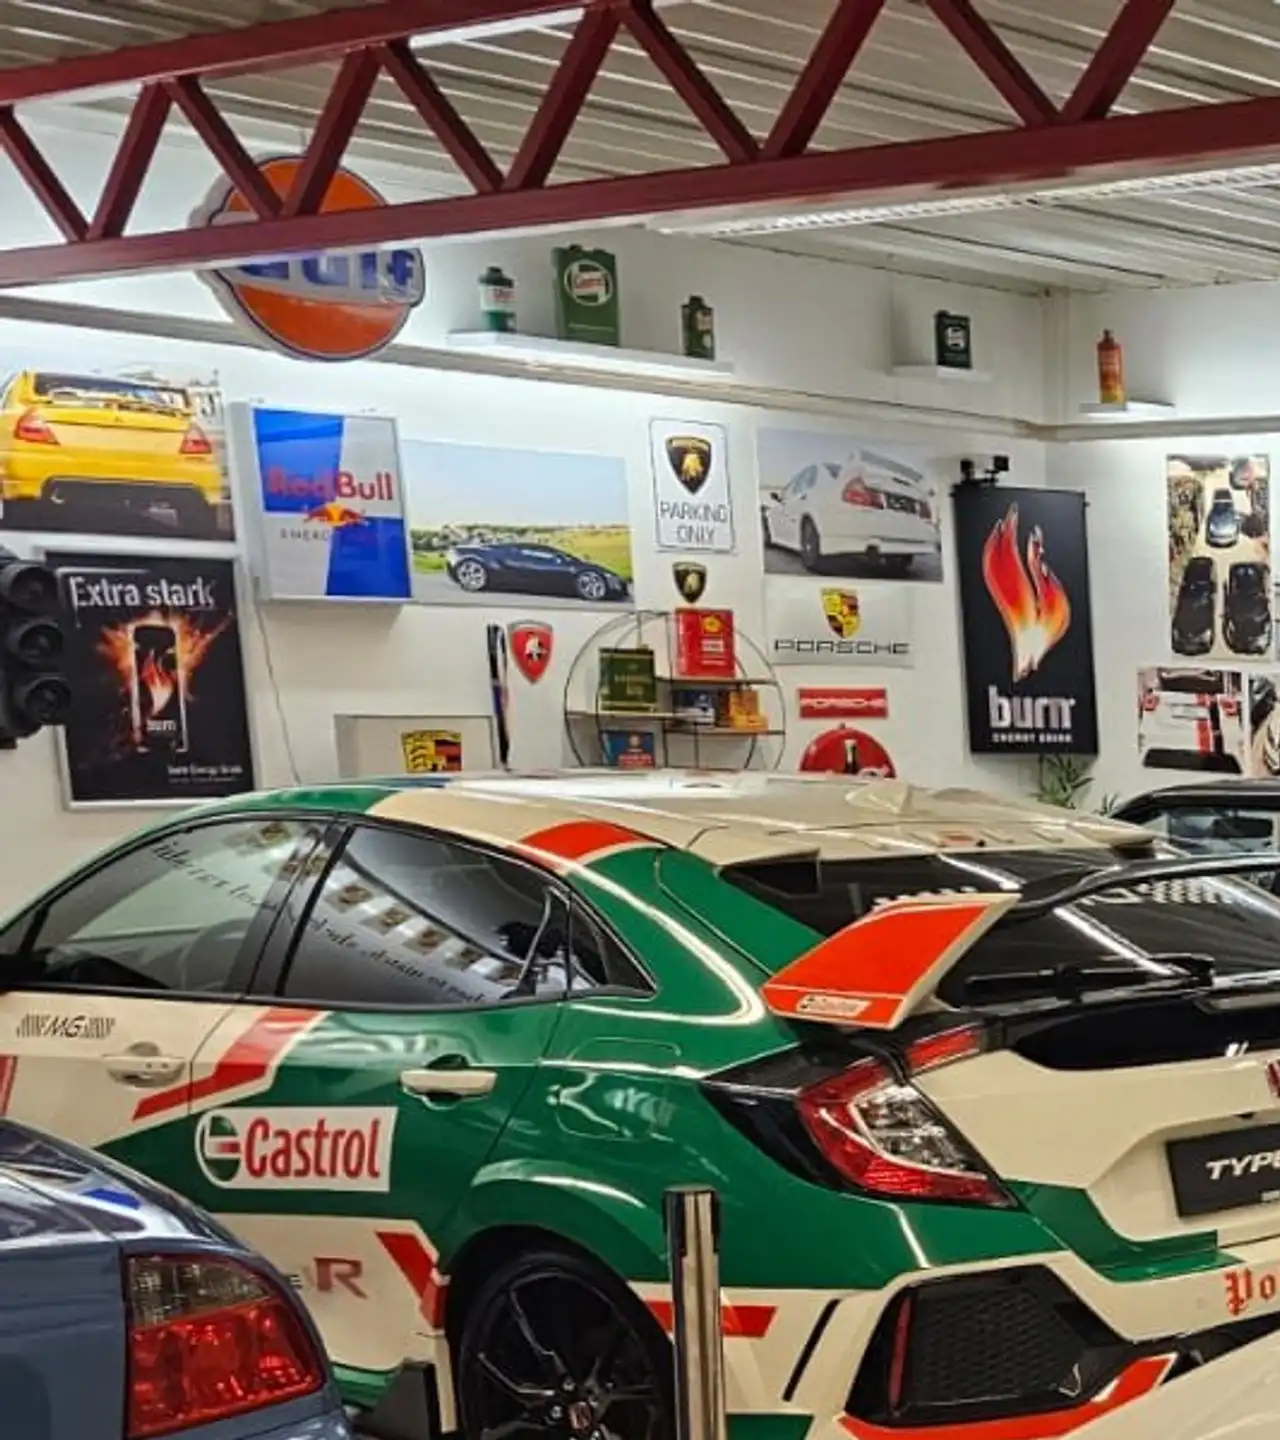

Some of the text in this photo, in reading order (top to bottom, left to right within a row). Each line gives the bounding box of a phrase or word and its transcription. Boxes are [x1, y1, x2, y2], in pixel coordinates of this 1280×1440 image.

[337, 471, 393, 501] Bull
[659, 500, 728, 523] PARKING
[676, 523, 715, 543] ONLY
[69, 575, 216, 609] Extra stark
[773, 639, 911, 655] PORSCHE
[988, 685, 1073, 730] burn
[244, 1116, 381, 1179] Castrol
